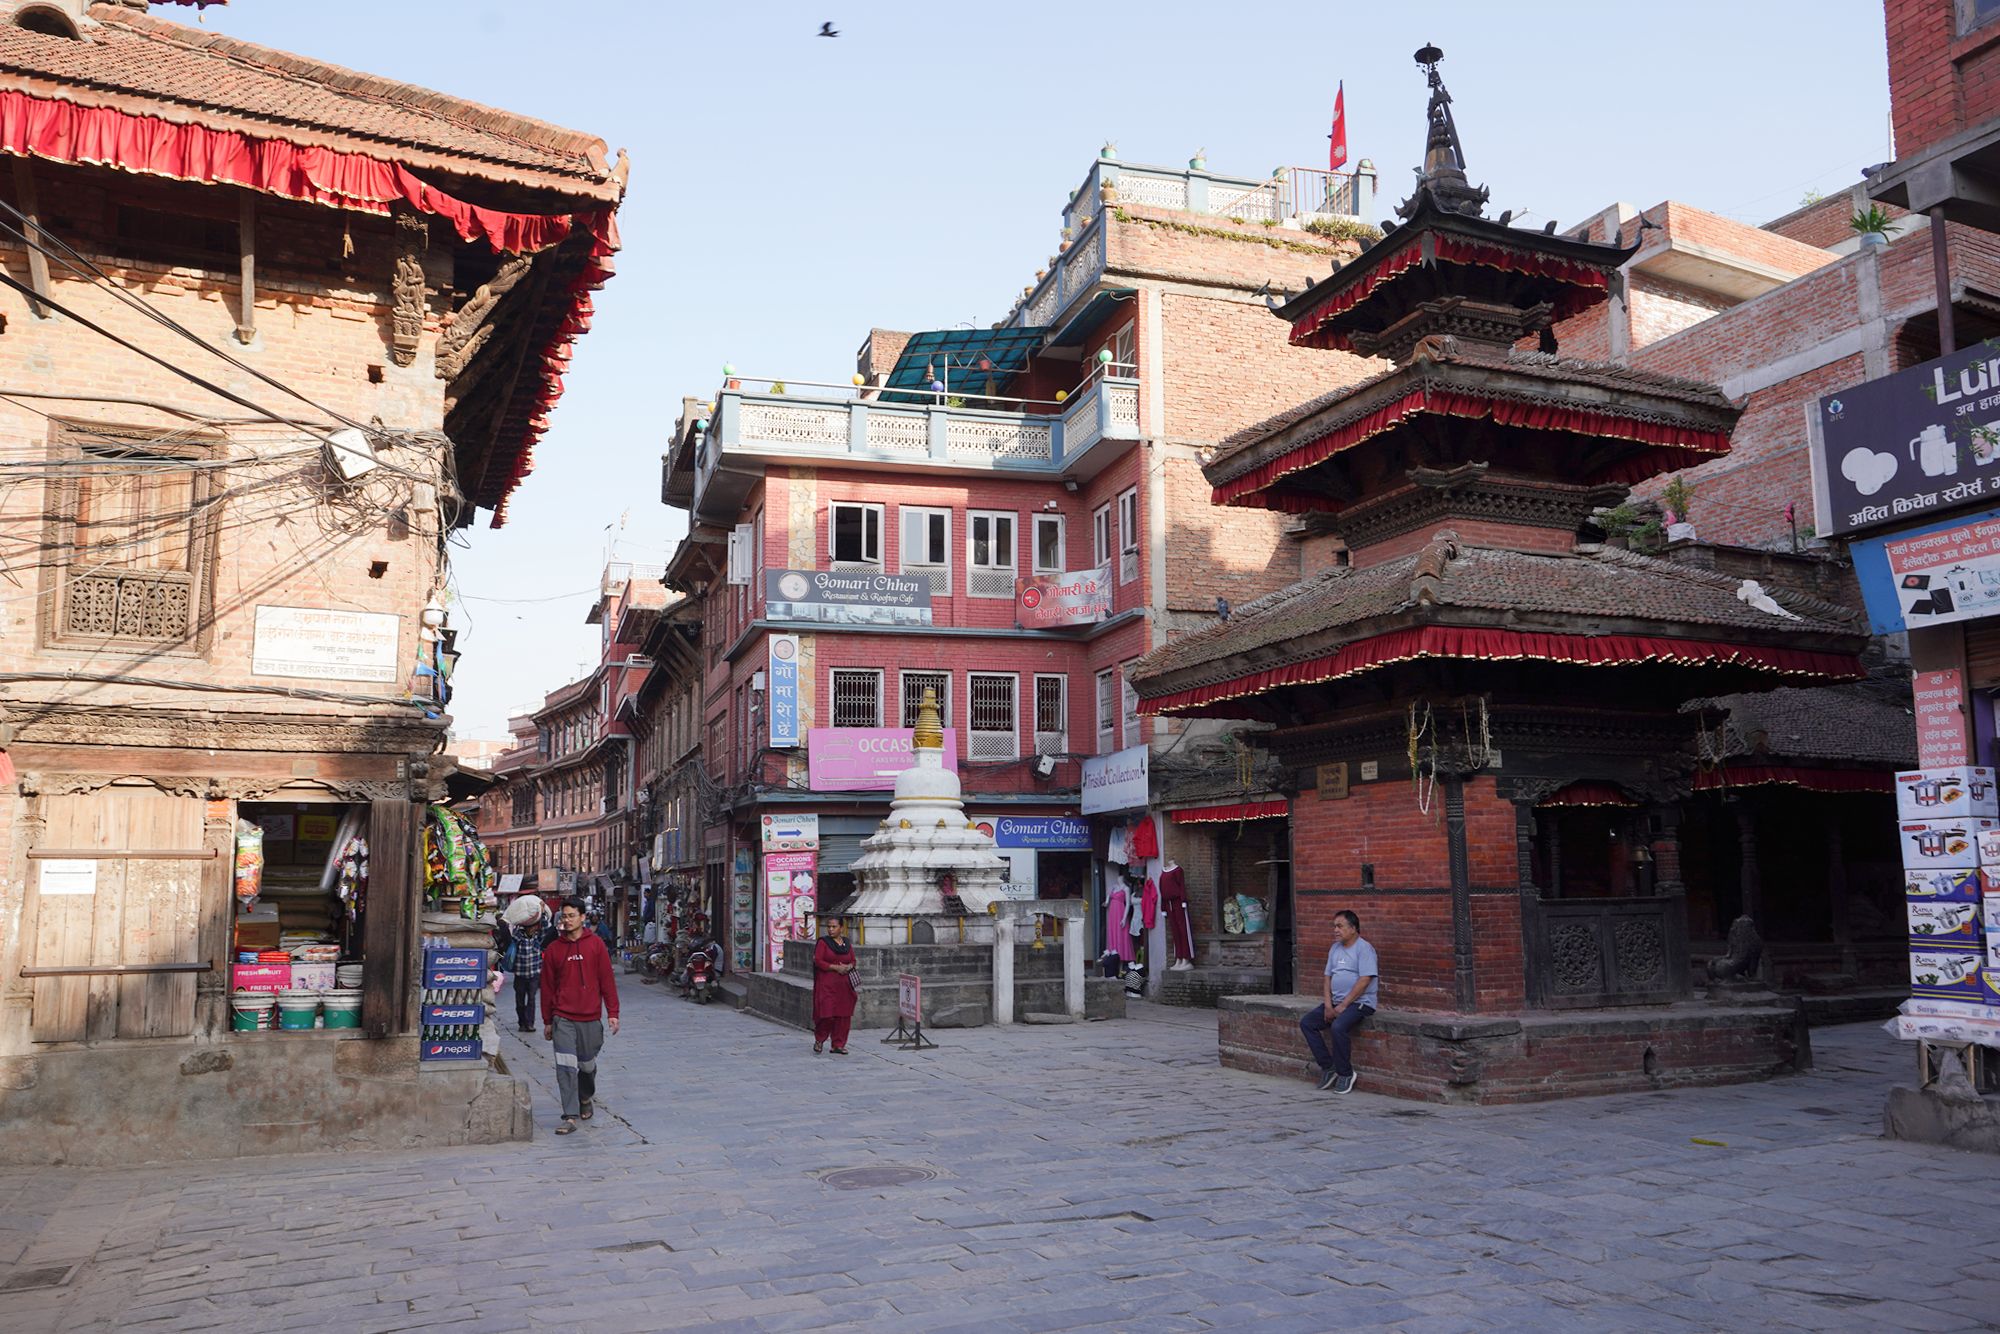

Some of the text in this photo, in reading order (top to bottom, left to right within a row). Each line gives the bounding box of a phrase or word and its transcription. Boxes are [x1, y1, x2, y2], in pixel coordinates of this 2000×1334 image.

[1956, 401, 1975, 416] अब
[1849, 505, 1889, 526] अदित
[1892, 493, 1938, 515] किचेन
[814, 573, 919, 592] Gomari Chhen
[822, 590, 915, 605] Restaurant & Rooftop Cafe
[858, 738, 914, 753] OCCASI
[772, 815, 816, 824] Gomari Chhen
[1001, 819, 1089, 835] Gomari Chhen
[567, 954, 584, 962] FILA
[444, 974, 477, 983] PEPSI
[442, 1010, 475, 1018] PEPSI
[444, 1044, 472, 1055] pepsi
